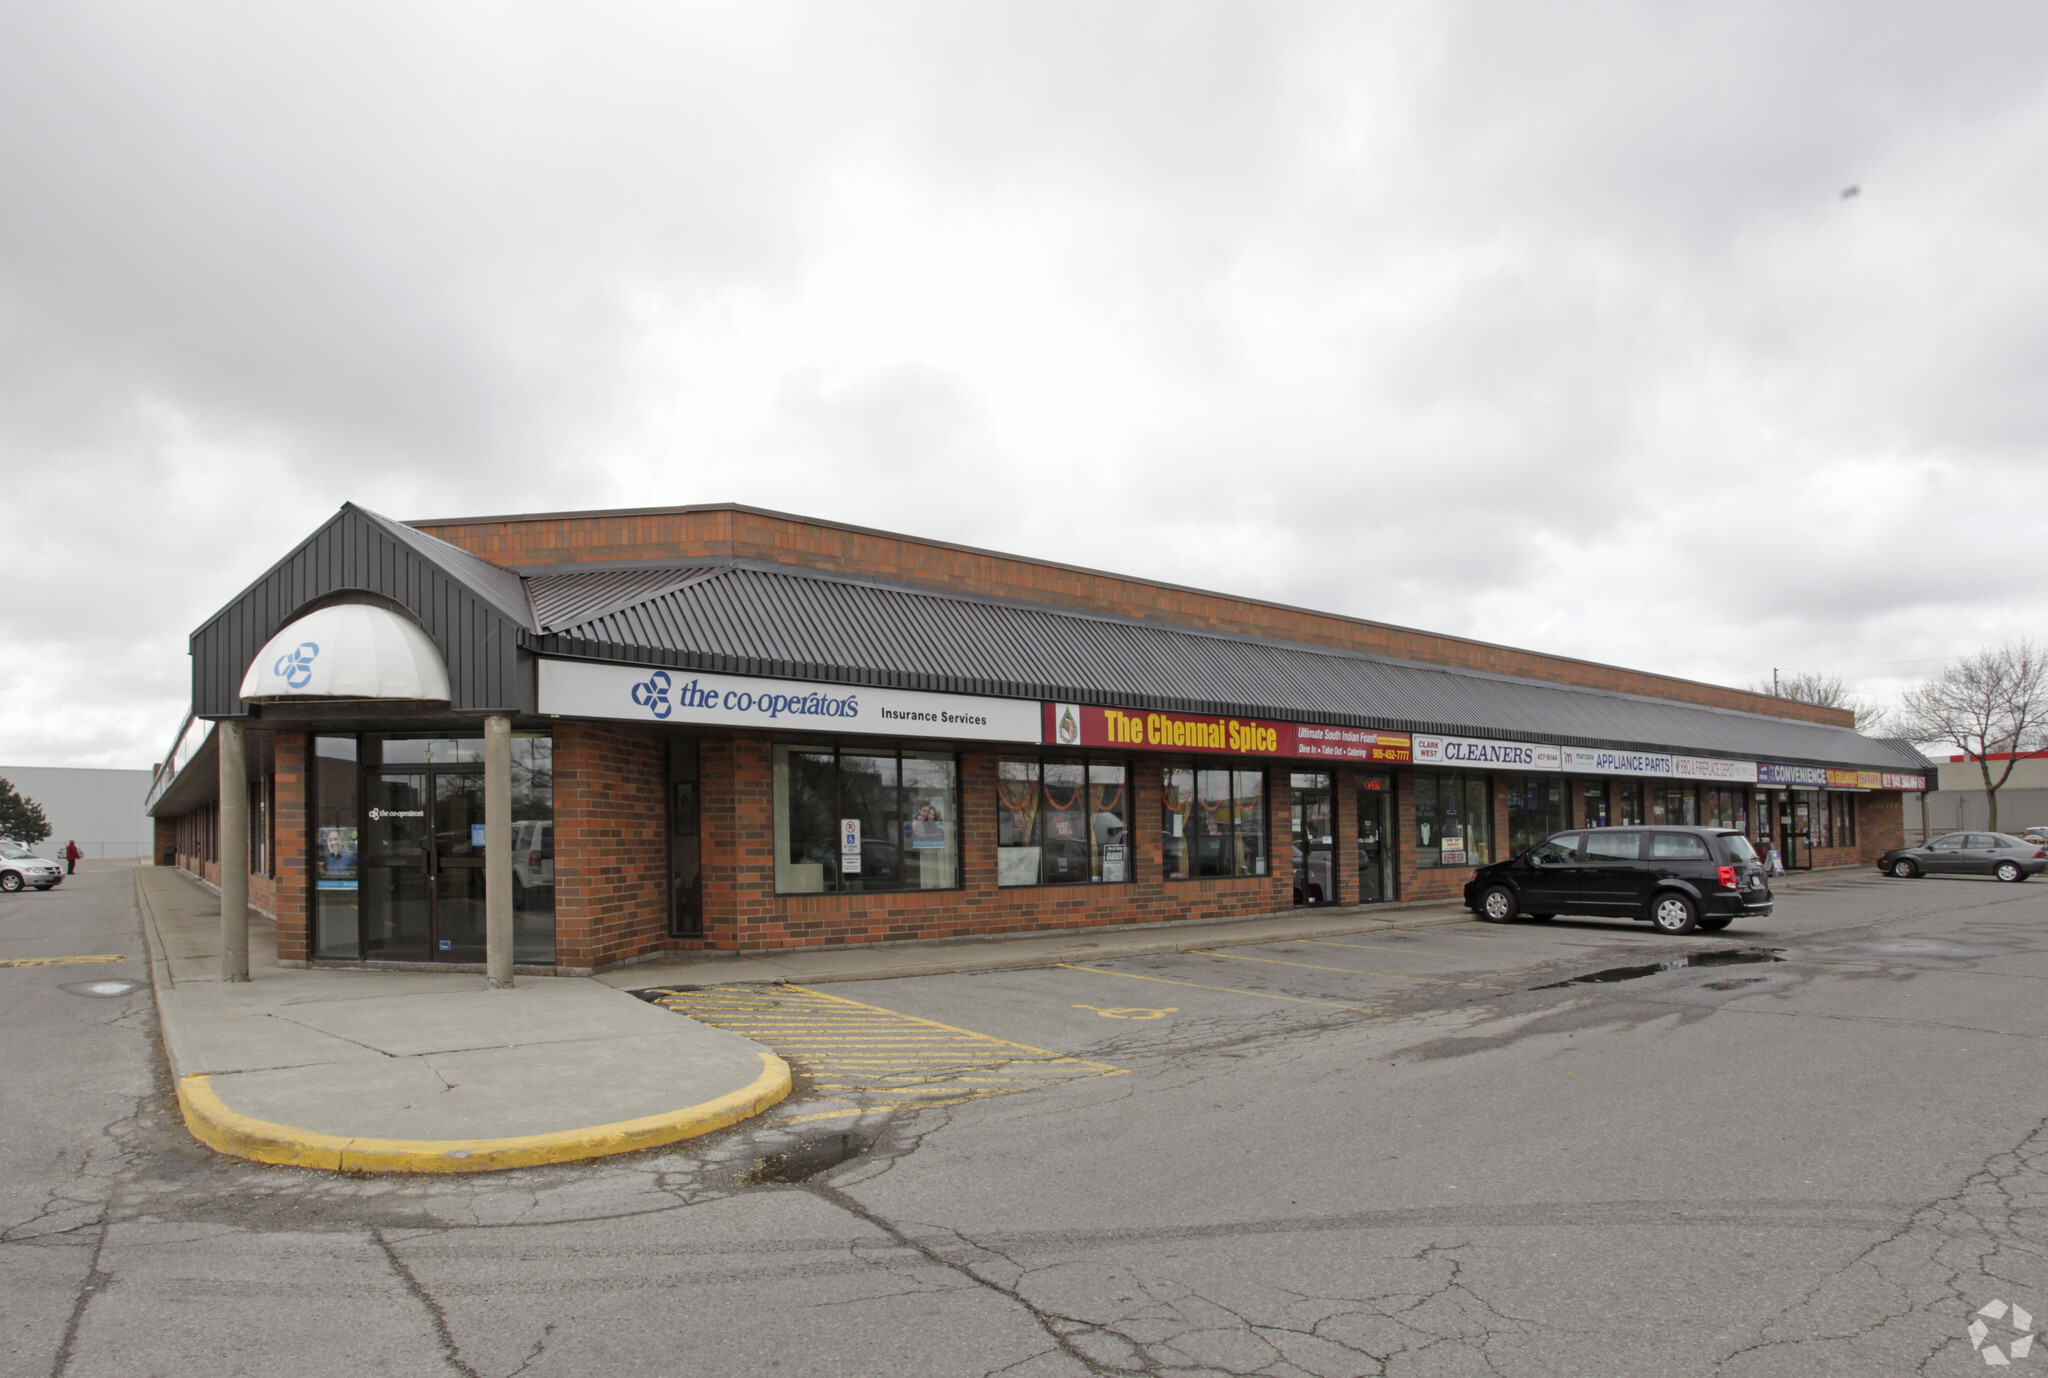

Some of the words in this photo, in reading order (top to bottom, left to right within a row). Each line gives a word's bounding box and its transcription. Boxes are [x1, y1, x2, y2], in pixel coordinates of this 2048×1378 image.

[680, 679, 718, 708] the
[881, 707, 937, 722] Insurance
[941, 711, 987, 725] Services
[1104, 709, 1143, 743] The
[1147, 713, 1226, 749] Chennai
[1229, 719, 1277, 753] Spice
[1298, 727, 1324, 740] Ultimate
[1324, 729, 1341, 741] South
[1342, 731, 1360, 742] Indian
[1298, 743, 1310, 753] Dine
[1311, 745, 1317, 754] In
[1322, 745, 1333, 755] Take
[1334, 746, 1343, 755] Out
[1346, 747, 1367, 758] Catering
[1418, 740, 1439, 749] CLARK
[1420, 749, 1438, 757] WEST
[1444, 742, 1533, 764] CLEANERS
[1372, 748, 1410, 760] 905-452-7777
[1596, 753, 1643, 771] APPLIANCE
[1645, 757, 1671, 773] PARTS
[1680, 759, 1691, 775] BBQ
[1695, 760, 1720, 776] FIREPLACE
[1720, 762, 1735, 777] DEPOT
[1774, 764, 1828, 784] CONVENIENCE
